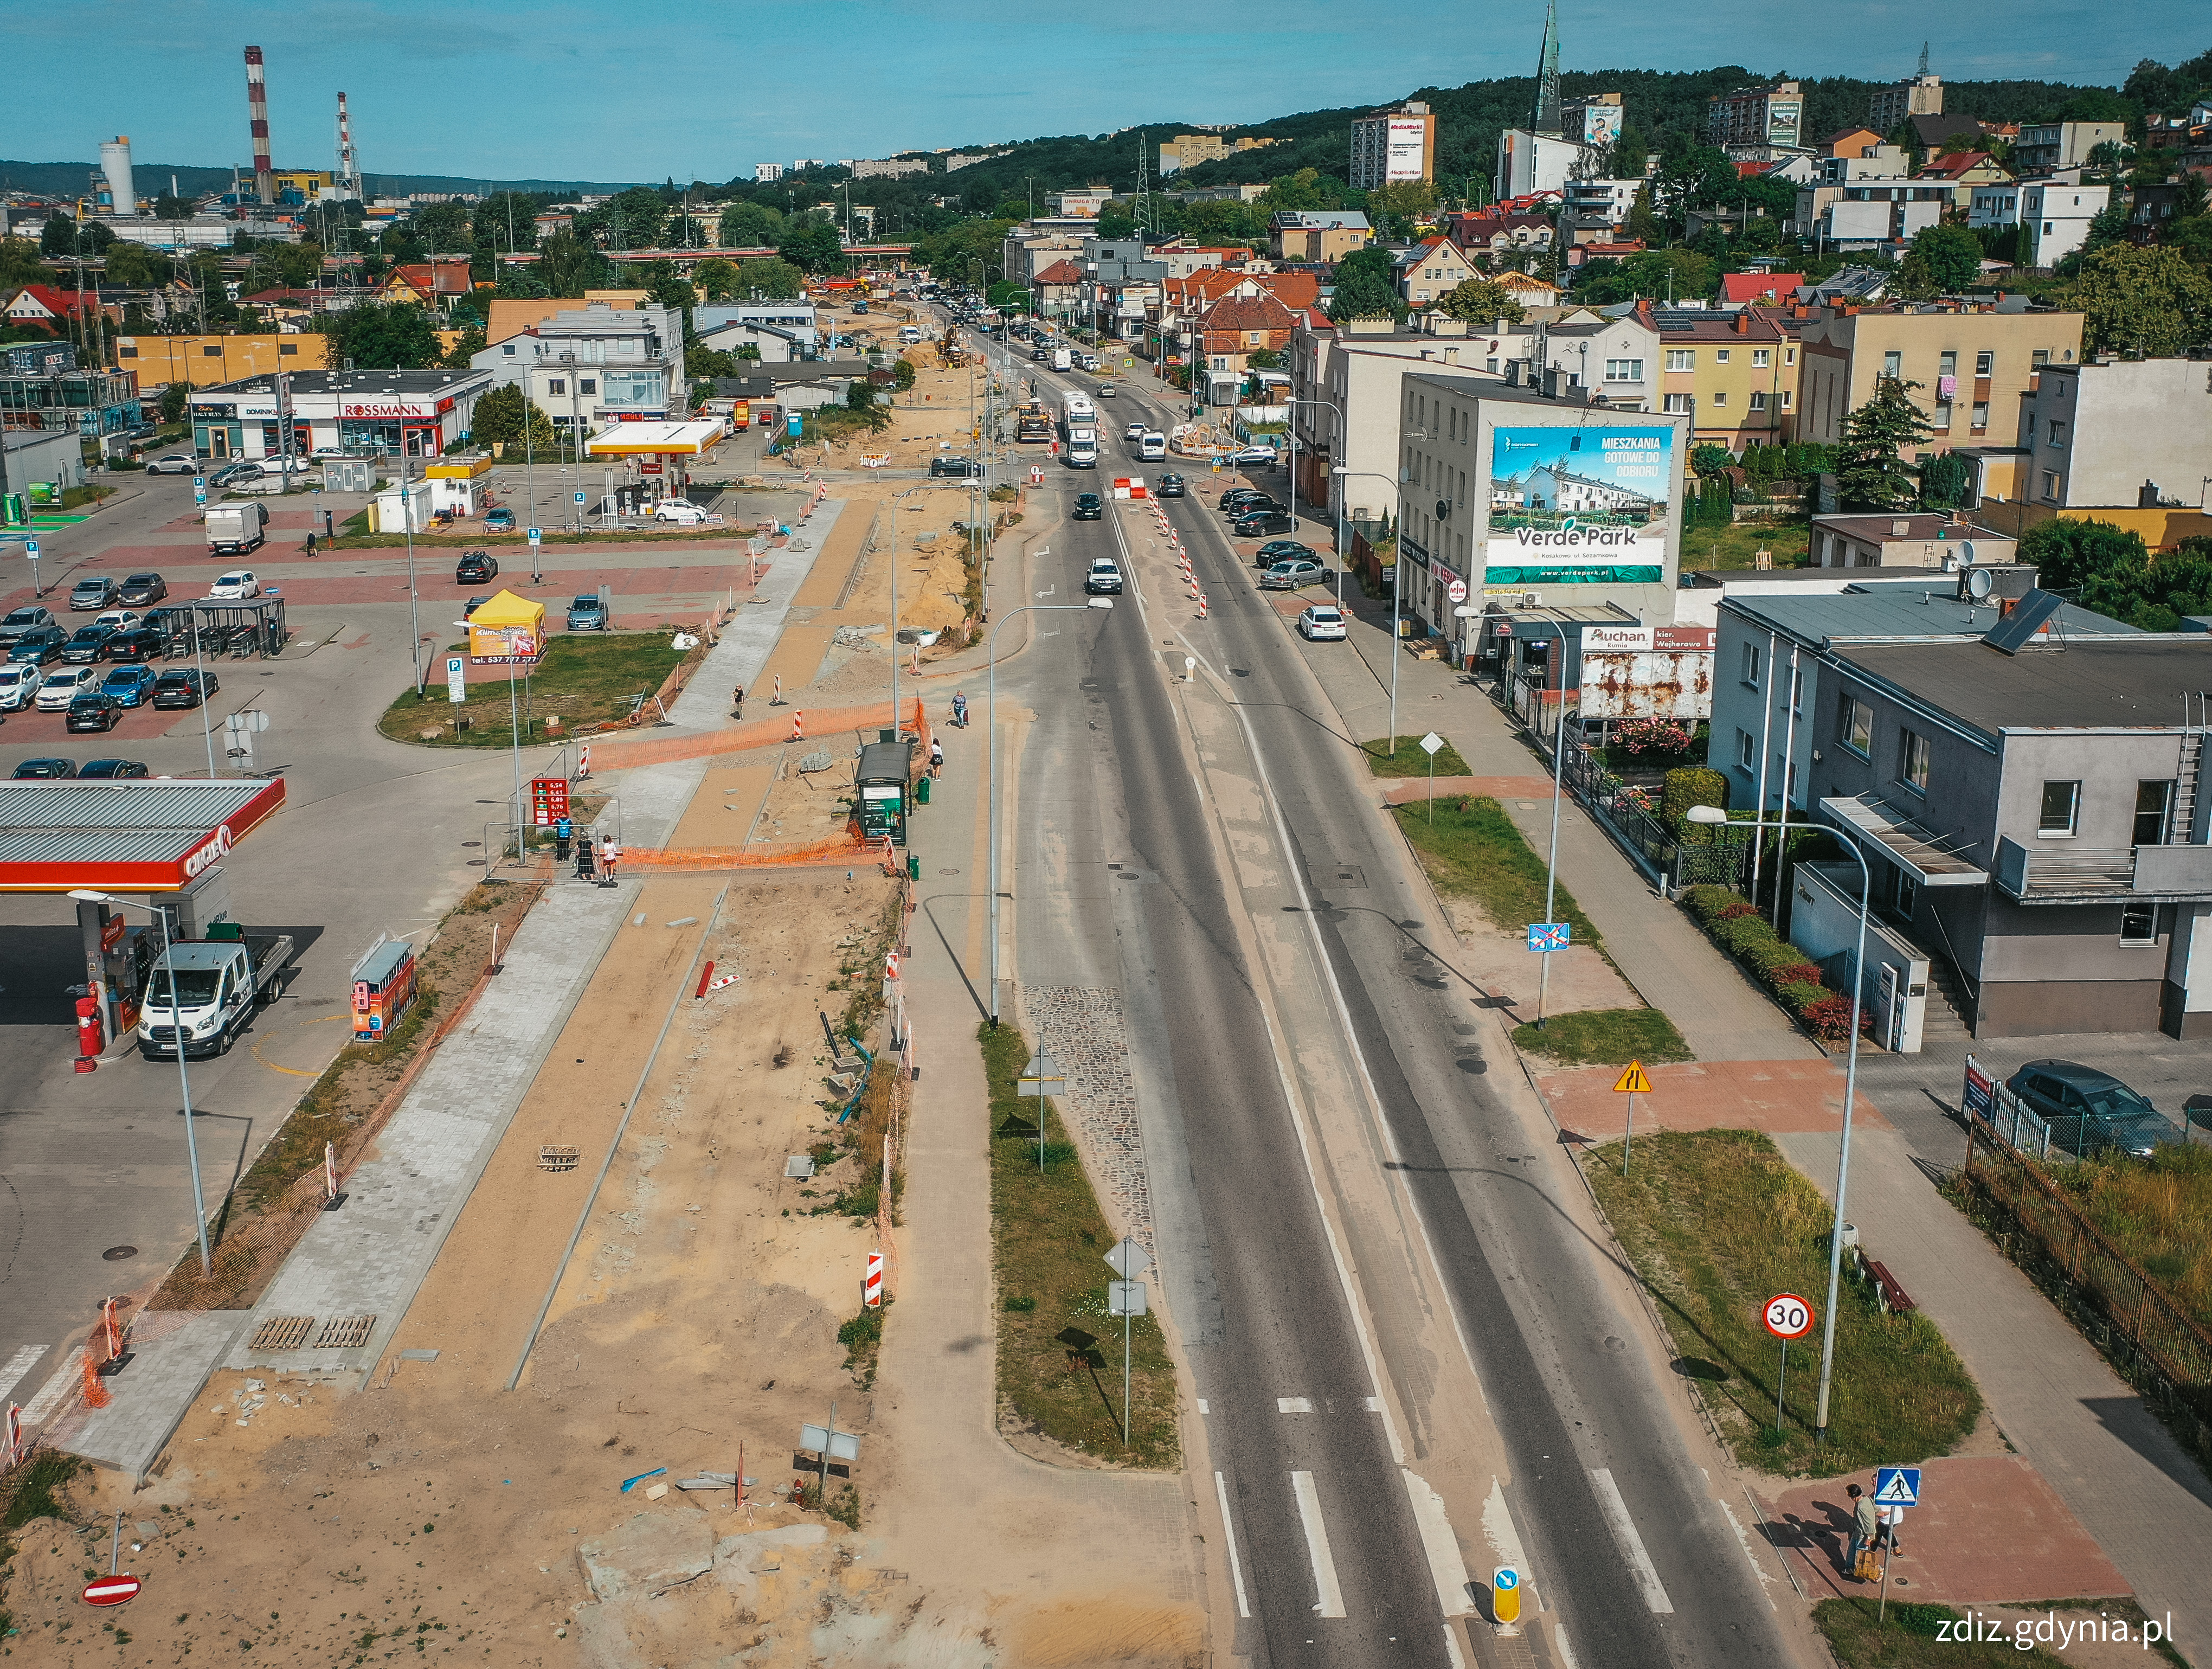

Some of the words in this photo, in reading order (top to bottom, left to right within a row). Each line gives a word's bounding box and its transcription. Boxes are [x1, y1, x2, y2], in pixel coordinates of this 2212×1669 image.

[345, 405, 421, 416] ROSSMANN
[1602, 438, 1660, 450] MIESZKANIA
[1604, 452, 1645, 464] GOTOWE
[1647, 452, 1659, 463] DO
[1617, 466, 1658, 477] ODBIORU
[1516, 528, 1580, 546] Verde
[1587, 528, 1636, 546] Park
[1590, 628, 1645, 641] Auchan
[1656, 640, 1701, 649] Wejherowo
[186, 839, 220, 877] CIRCLE
[1770, 1304, 1805, 1328] 30
